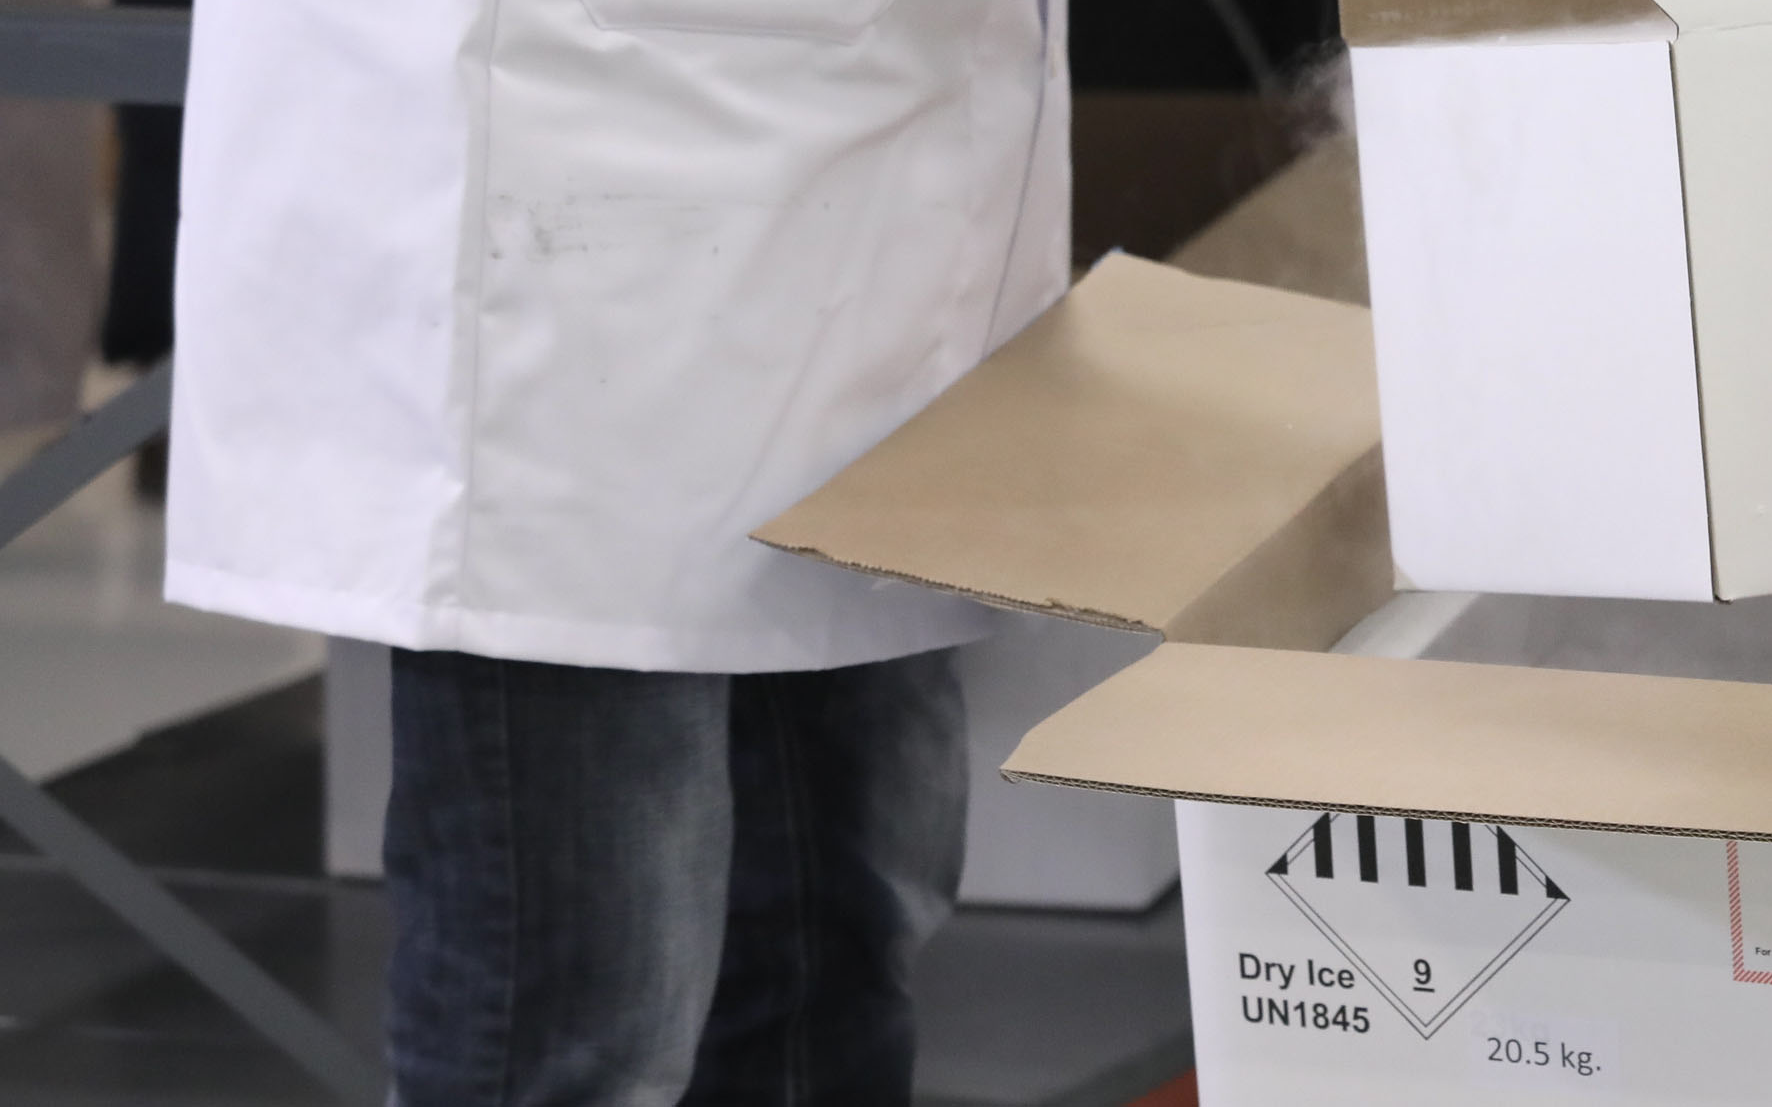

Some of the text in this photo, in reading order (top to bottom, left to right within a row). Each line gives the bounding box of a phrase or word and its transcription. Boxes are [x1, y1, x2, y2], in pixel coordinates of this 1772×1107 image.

[1755, 946, 1772, 957] For
[1238, 952, 1355, 991] Dry Ice
[1413, 958, 1433, 989] 9
[1241, 995, 1371, 1034] UN1845
[1486, 1036, 1602, 1077] 20.5 kg.
